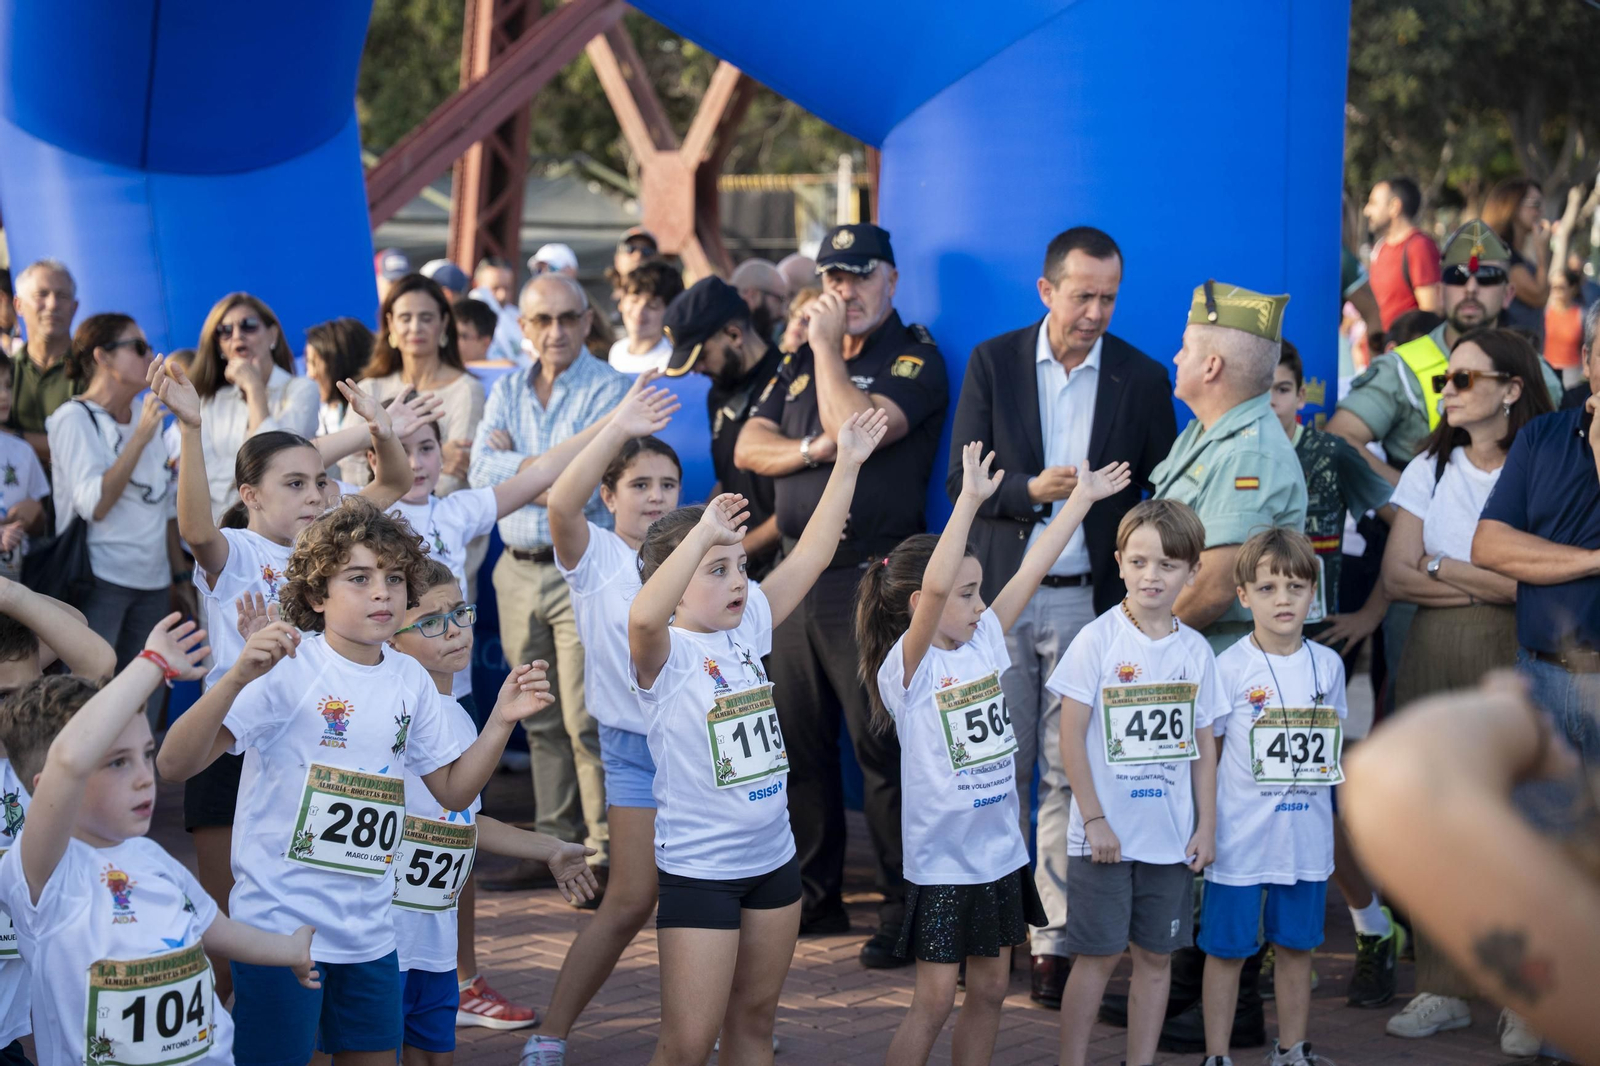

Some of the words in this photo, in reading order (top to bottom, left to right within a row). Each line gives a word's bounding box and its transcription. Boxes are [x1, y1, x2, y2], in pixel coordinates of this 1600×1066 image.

[1125, 708, 1184, 742] 426
[732, 713, 782, 759] 115
[319, 739, 346, 749] AIDA
[1266, 732, 1325, 763] 432
[314, 768, 331, 782] LA
[318, 782, 346, 793] ALMERÍA
[350, 787, 380, 798] ROQUETAS
[971, 778, 1004, 790] VOLUNTARIO
[320, 802, 397, 851] 280
[345, 851, 369, 860] MARCO
[370, 853, 386, 862] LÓPEZ
[405, 848, 466, 889] 521
[98, 964, 116, 977] LA
[103, 978, 137, 987] ALMERÍA
[122, 979, 205, 1043] 104
[161, 1039, 190, 1053] ANTONIO
